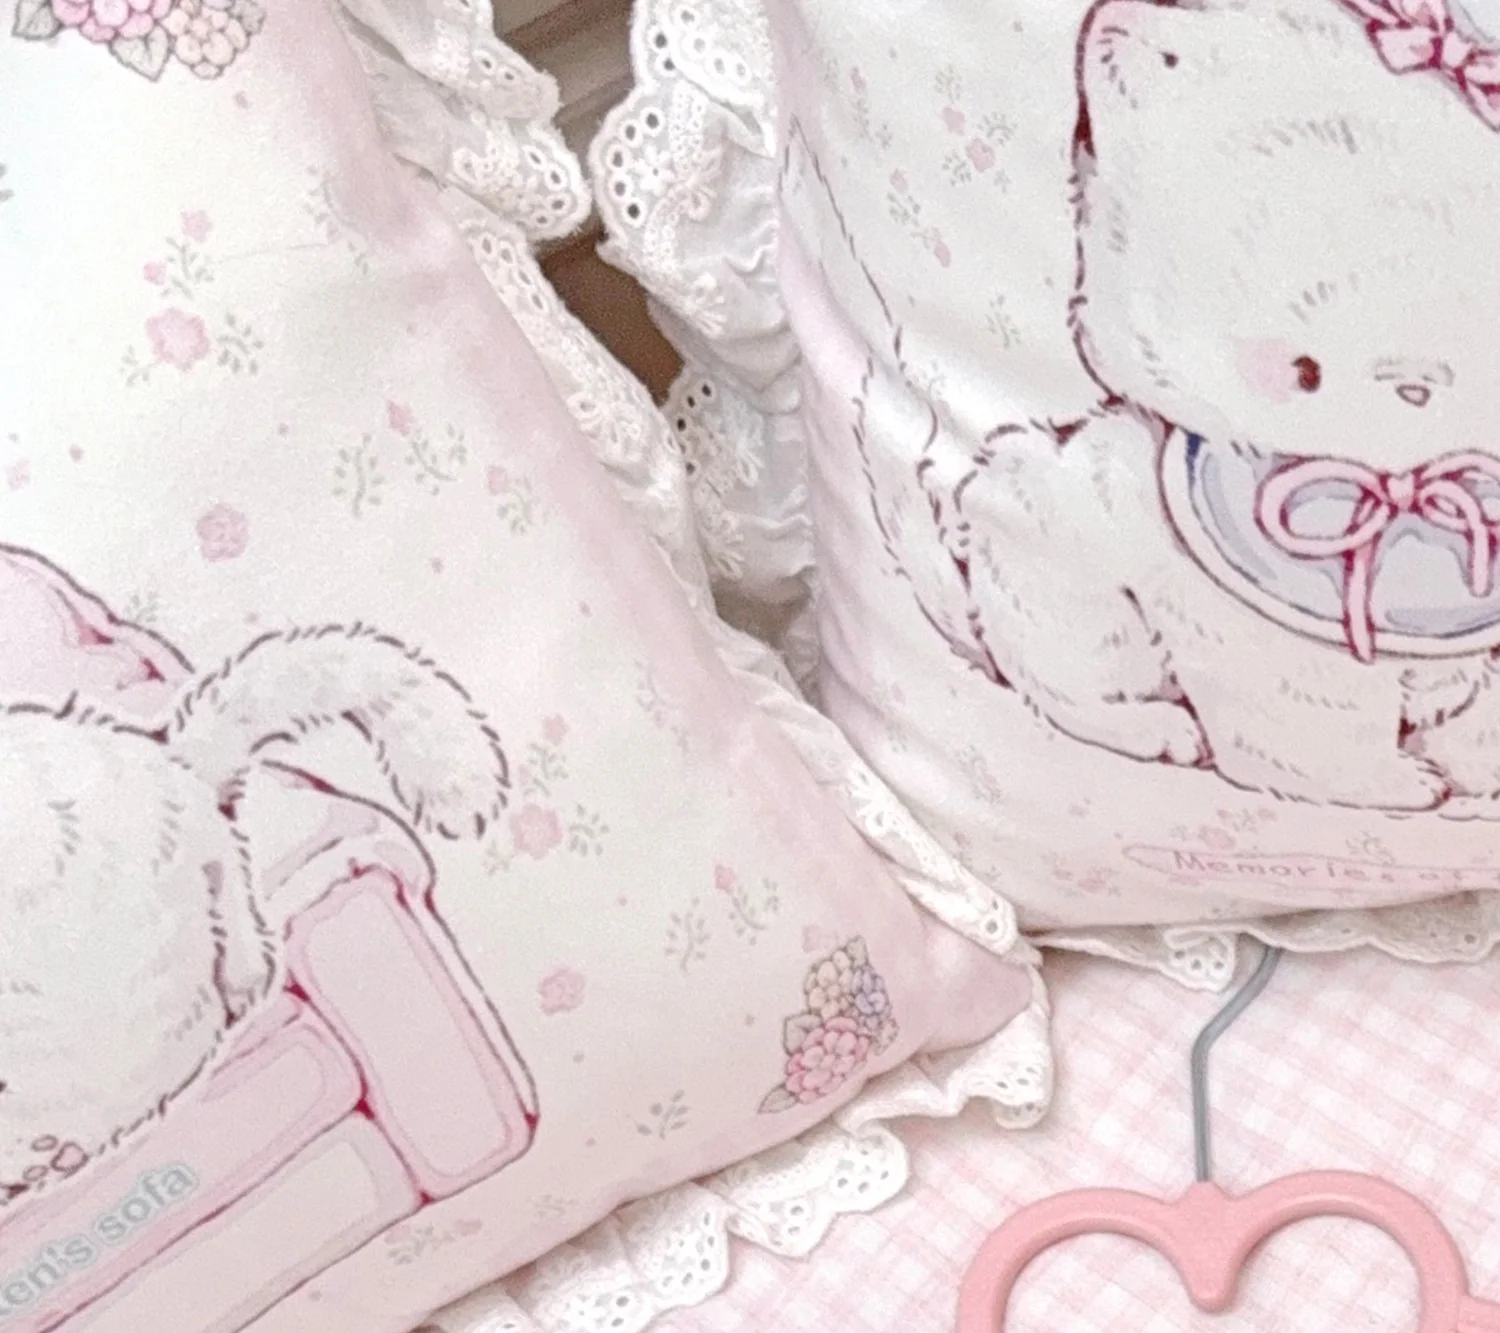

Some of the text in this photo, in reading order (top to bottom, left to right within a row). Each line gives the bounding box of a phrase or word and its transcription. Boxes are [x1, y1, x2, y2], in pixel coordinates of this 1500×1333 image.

[1172, 849, 1395, 883] Memories
[0, 1165, 195, 1316] en's sofa
